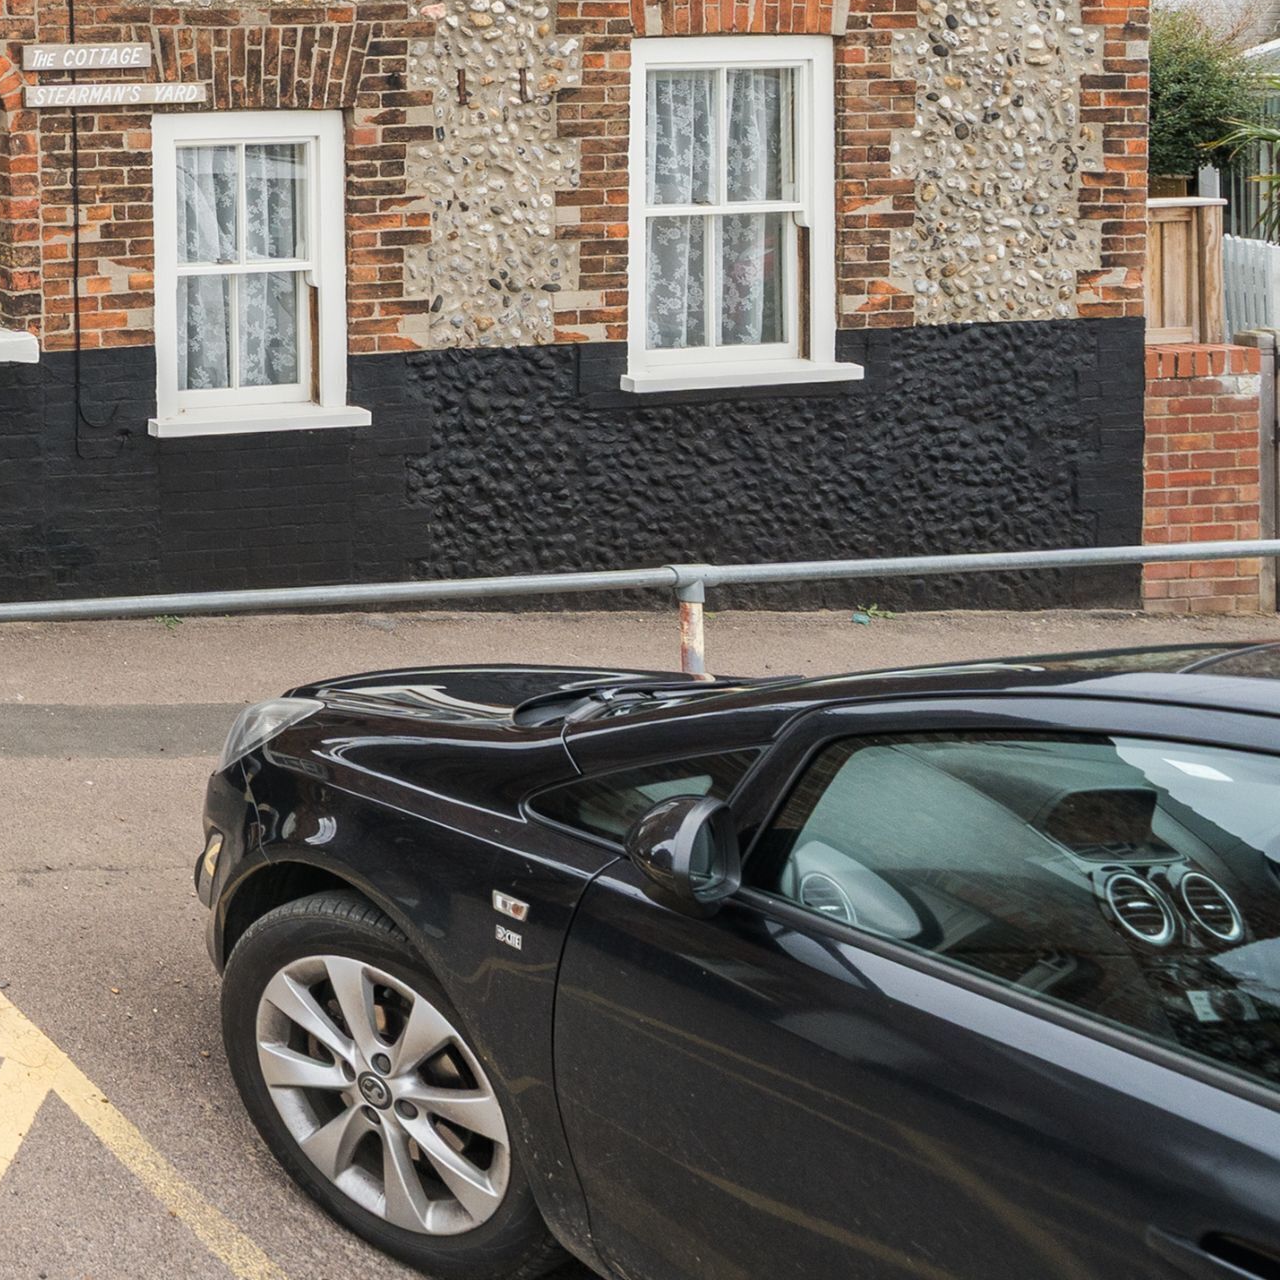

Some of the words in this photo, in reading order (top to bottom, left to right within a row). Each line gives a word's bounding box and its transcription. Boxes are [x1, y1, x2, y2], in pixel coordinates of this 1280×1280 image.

[32, 49, 56, 68] THE
[62, 46, 144, 67] COTTAGE
[34, 85, 142, 105] STEARMAN'S
[153, 84, 199, 102] YARD
